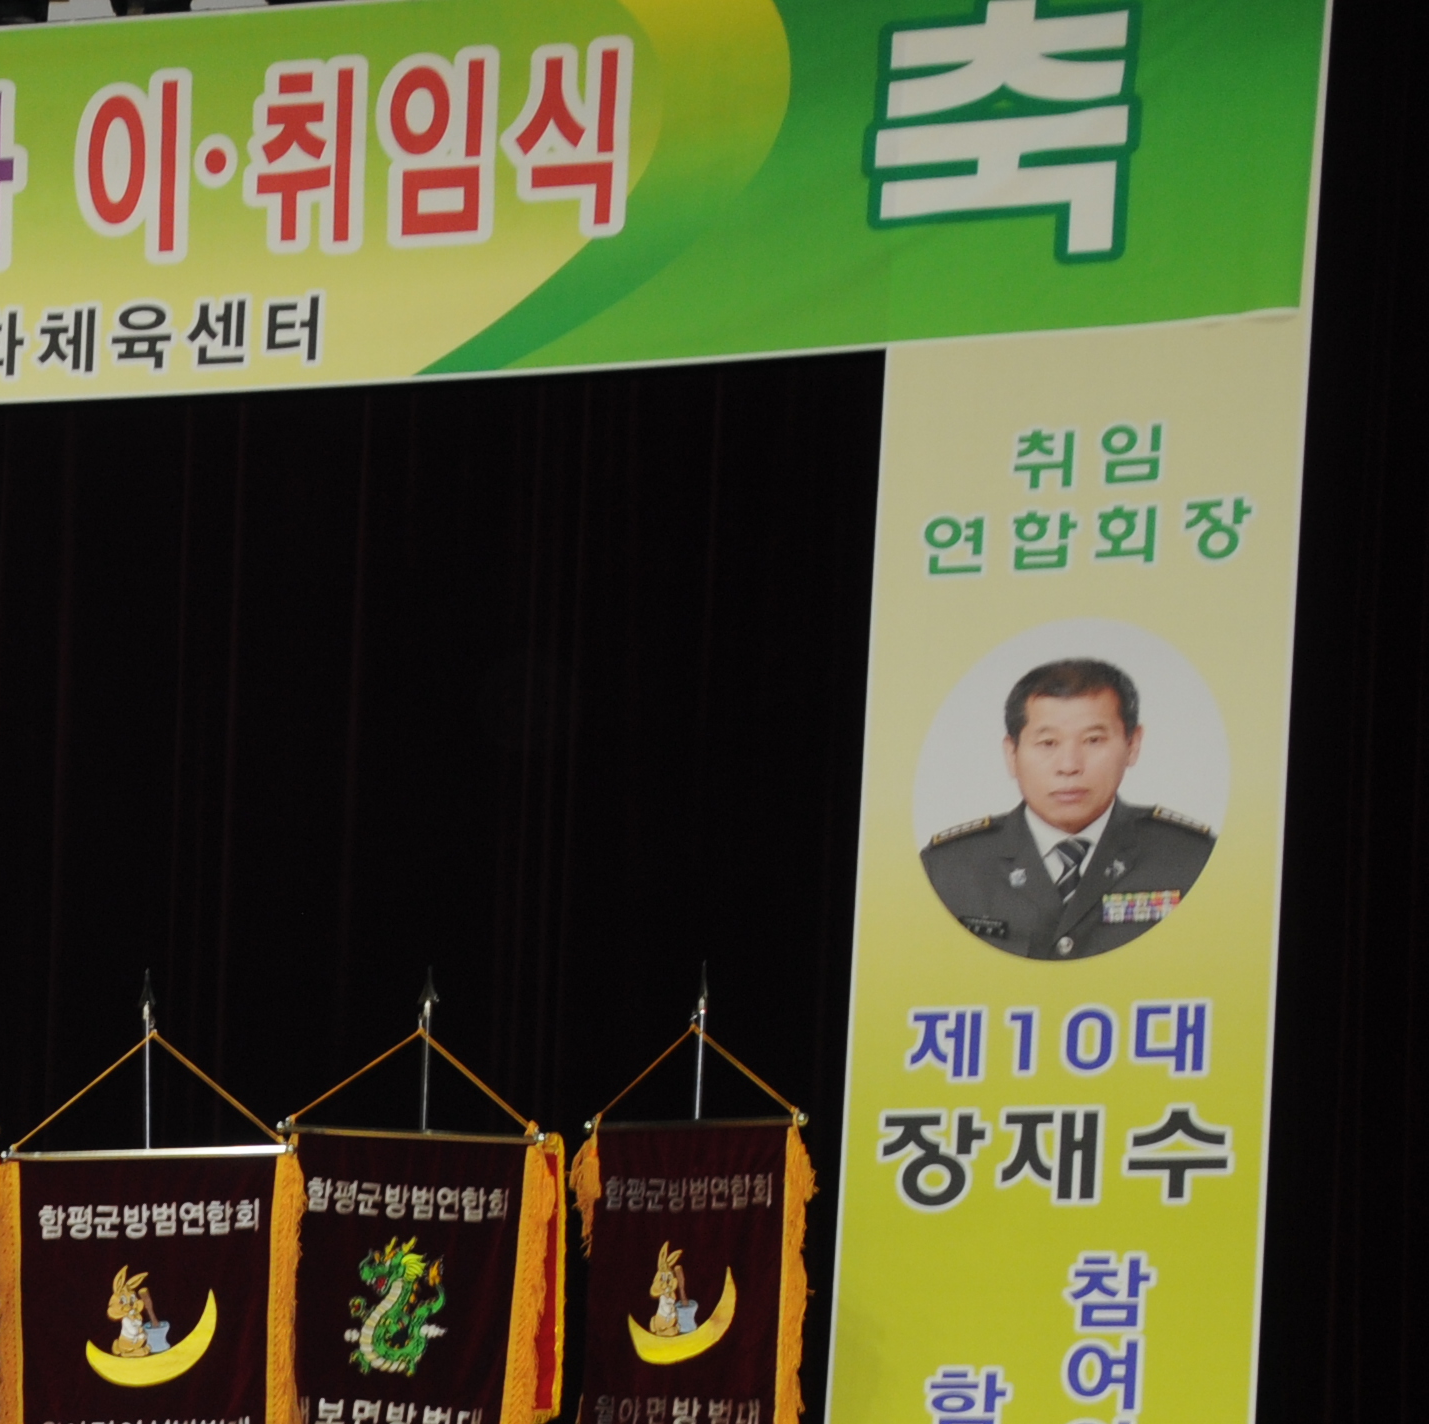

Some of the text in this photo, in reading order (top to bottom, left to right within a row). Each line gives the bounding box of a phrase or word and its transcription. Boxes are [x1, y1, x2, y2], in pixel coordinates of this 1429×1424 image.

[87, 47, 620, 253] 이·취임식
[874, 0, 1130, 255] 축
[1013, 423, 1163, 489] 취임
[923, 497, 1252, 576] 연합회장
[908, 1002, 1207, 1078] 제10대
[604, 1172, 773, 1214] 함평군방범연합회
[877, 1106, 1233, 1207] 장재수
[38, 1199, 261, 1240] 함평군방범연합회
[306, 1176, 510, 1224] 함평군방범연합회
